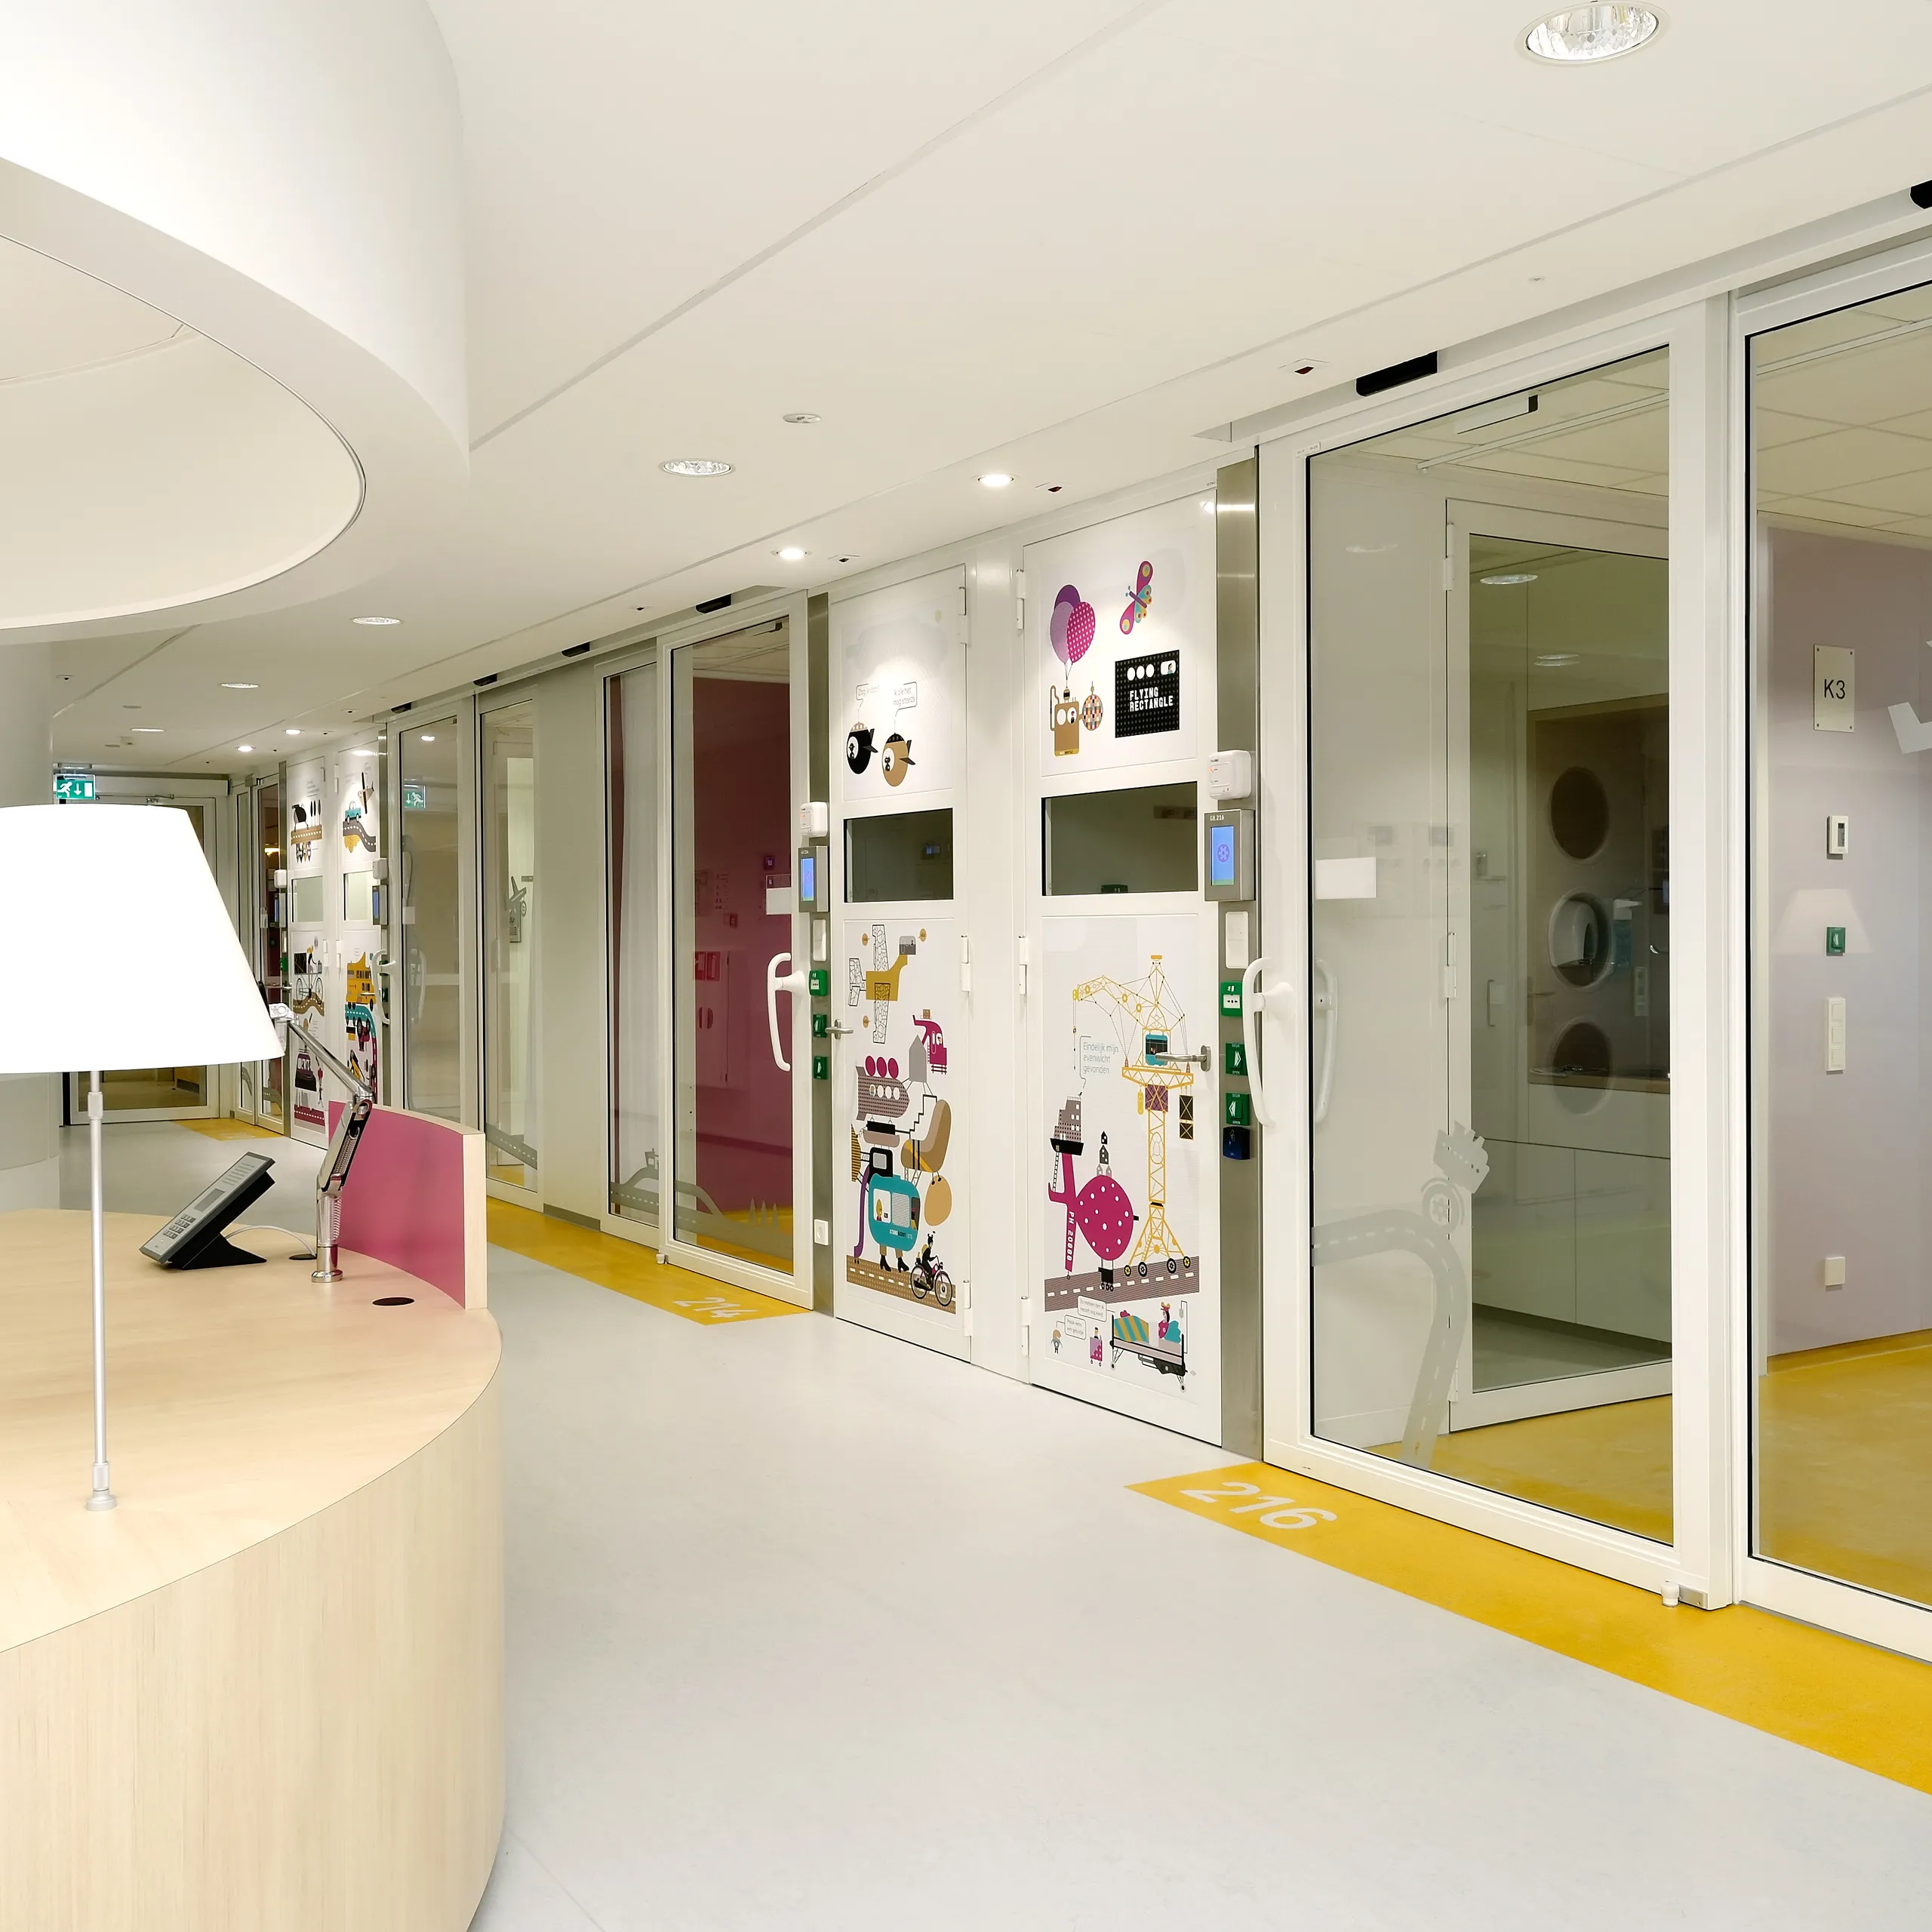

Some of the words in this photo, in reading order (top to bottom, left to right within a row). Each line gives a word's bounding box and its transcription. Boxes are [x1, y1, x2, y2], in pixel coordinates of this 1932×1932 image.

[1129, 686, 1158, 701] FLYING
[1824, 678, 1846, 700] K3
[902, 695, 915, 704] steeds
[1129, 695, 1174, 712] RECTANGLE
[1083, 1041, 1106, 1054] Eindelijk
[1106, 1044, 1118, 1055] mijn
[1083, 1054, 1111, 1063] evenwicht
[1083, 1065, 1110, 1075] gevonden
[1069, 1211, 1075, 1224] PH
[672, 1297, 758, 1318] 214
[1179, 1481, 1337, 1530] 216
